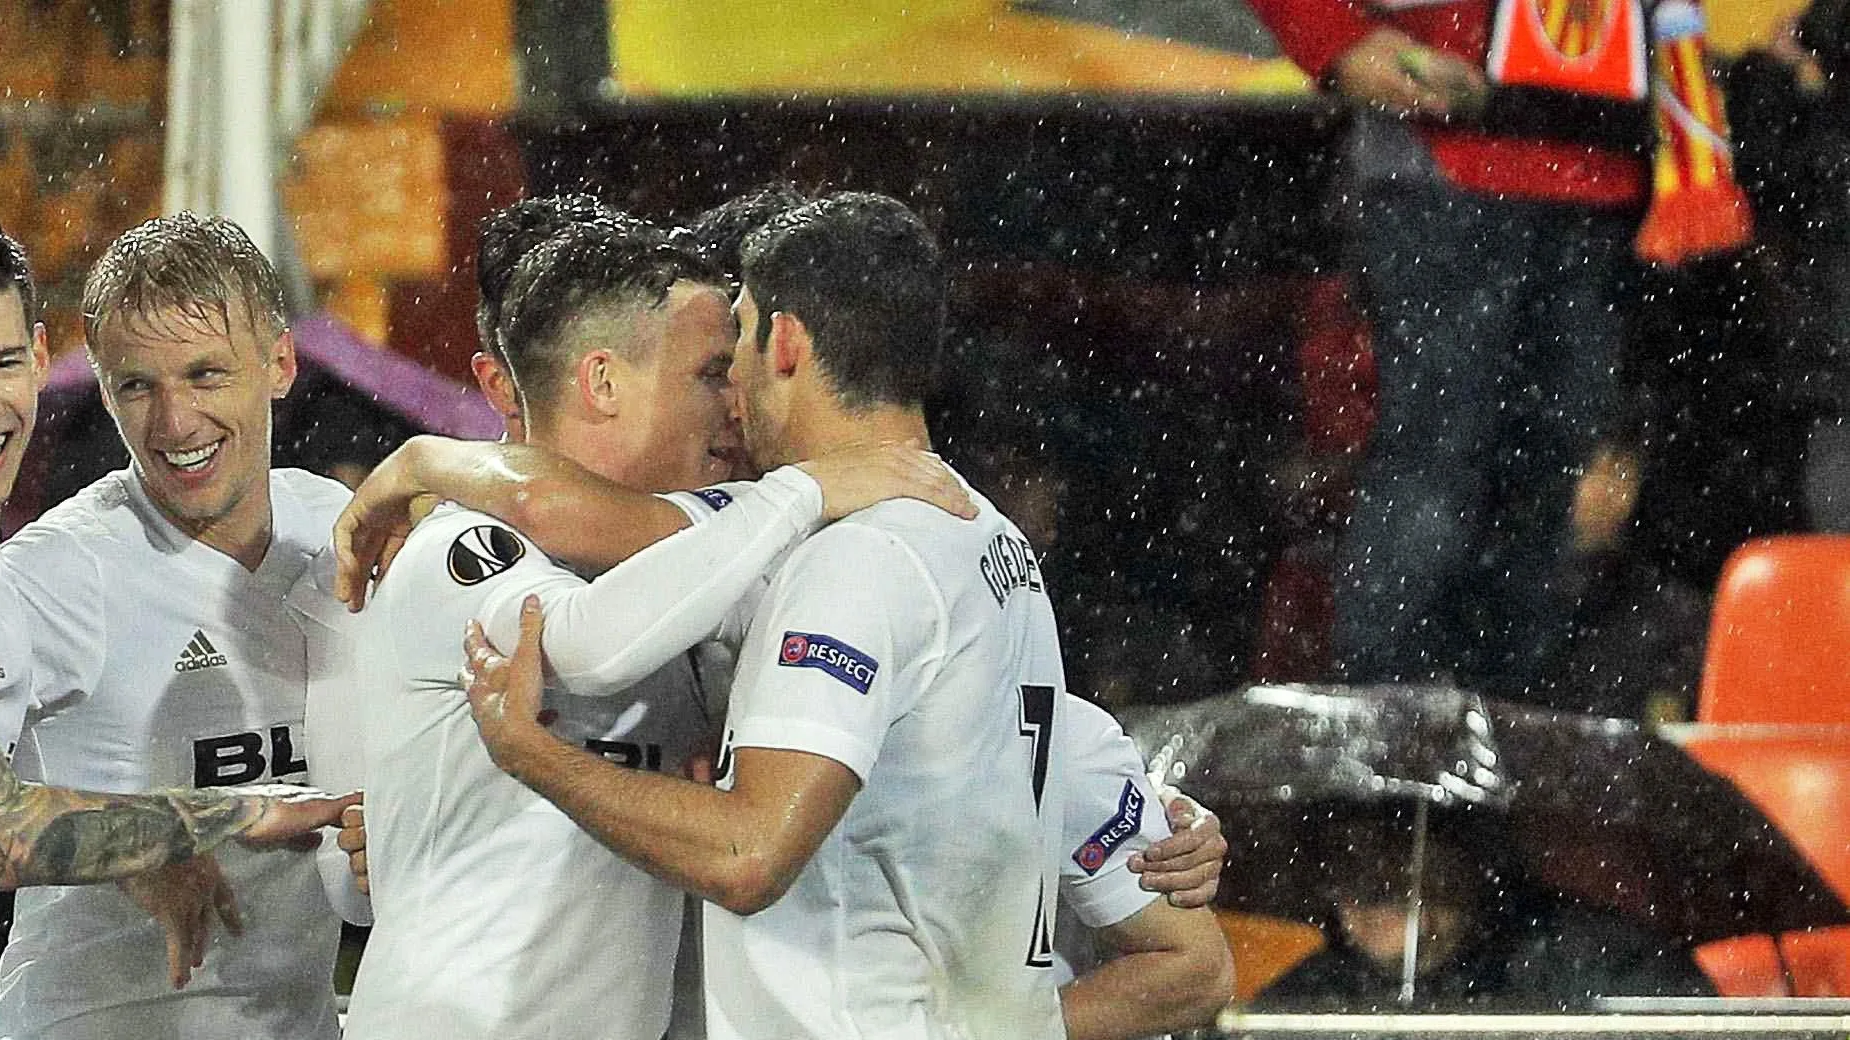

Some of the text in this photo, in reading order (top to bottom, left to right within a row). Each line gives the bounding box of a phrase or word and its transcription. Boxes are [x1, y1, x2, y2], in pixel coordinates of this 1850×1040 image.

[175, 653, 228, 673] adidas
[806, 643, 875, 684] RESPECT
[1100, 786, 1141, 848] RESPECT
